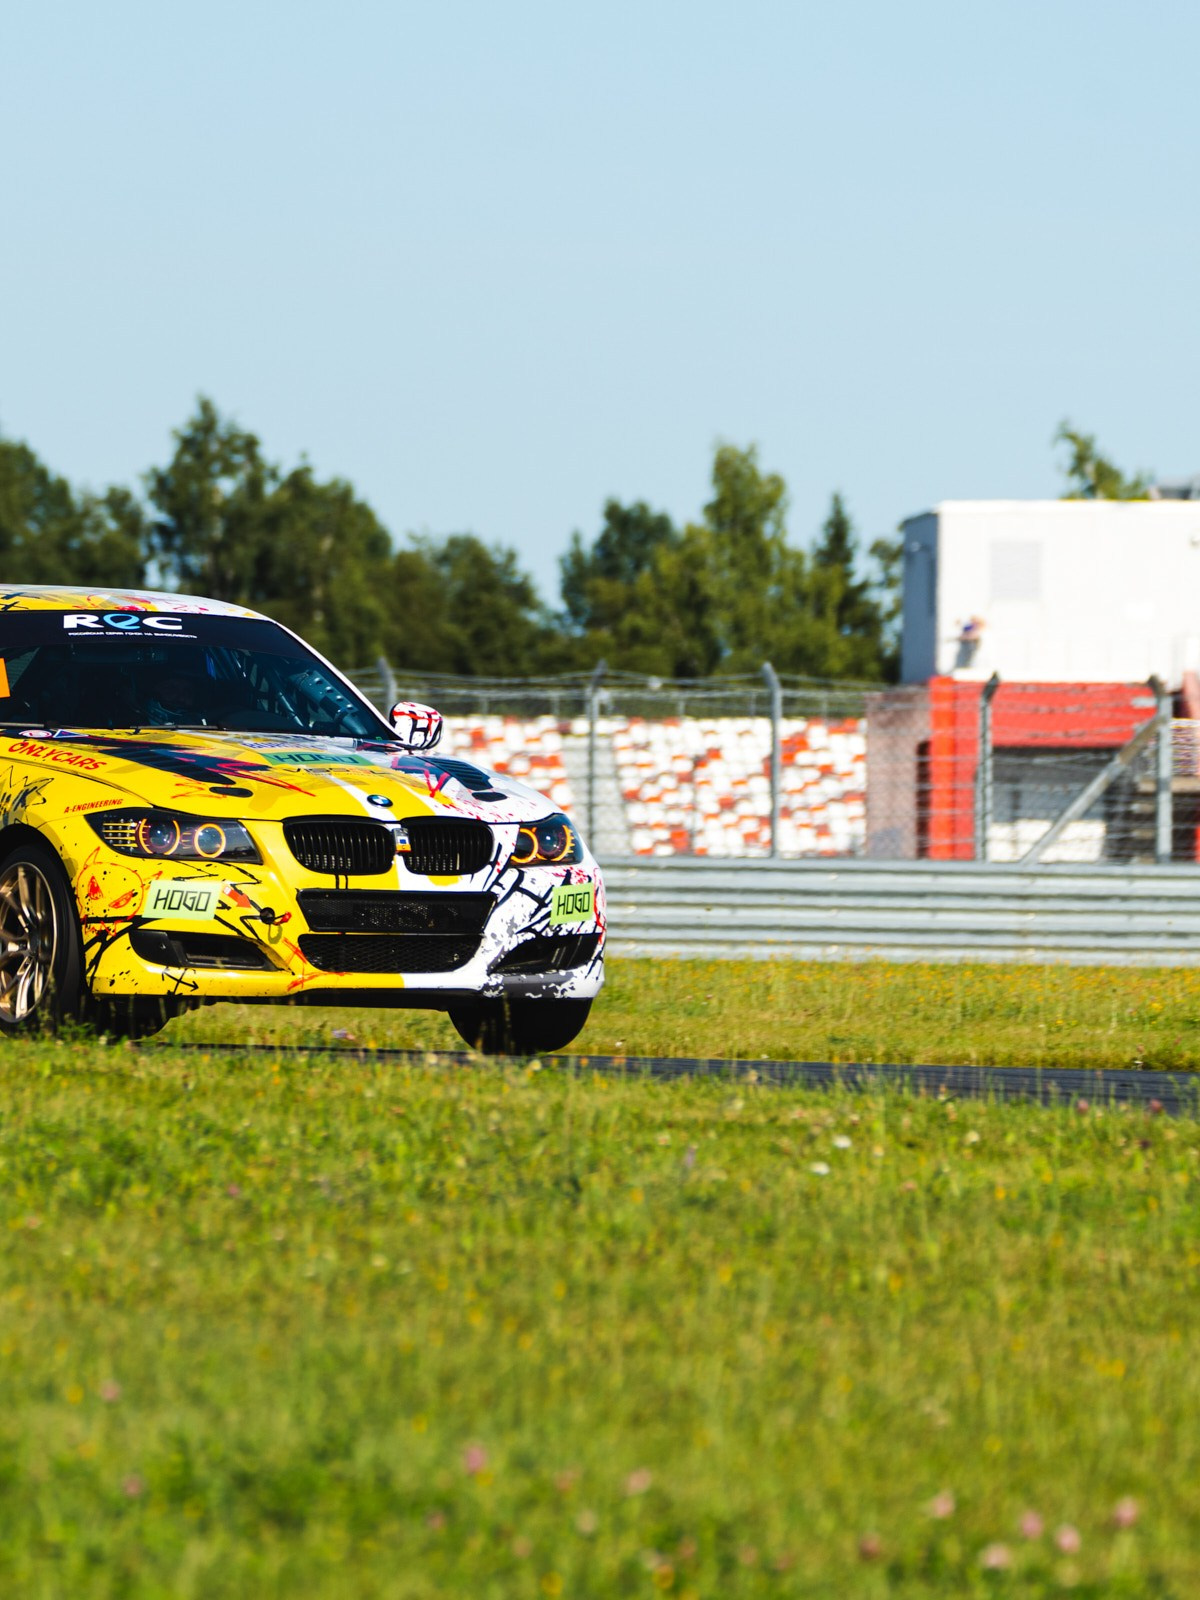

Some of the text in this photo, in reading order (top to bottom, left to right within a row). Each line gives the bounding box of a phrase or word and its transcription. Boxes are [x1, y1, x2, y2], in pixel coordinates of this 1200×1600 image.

[8, 741, 107, 770] ONLYCARS
[64, 799, 123, 814] A-ENGINEERING
[153, 889, 212, 912] HOGO
[556, 892, 591, 916] HOGO
